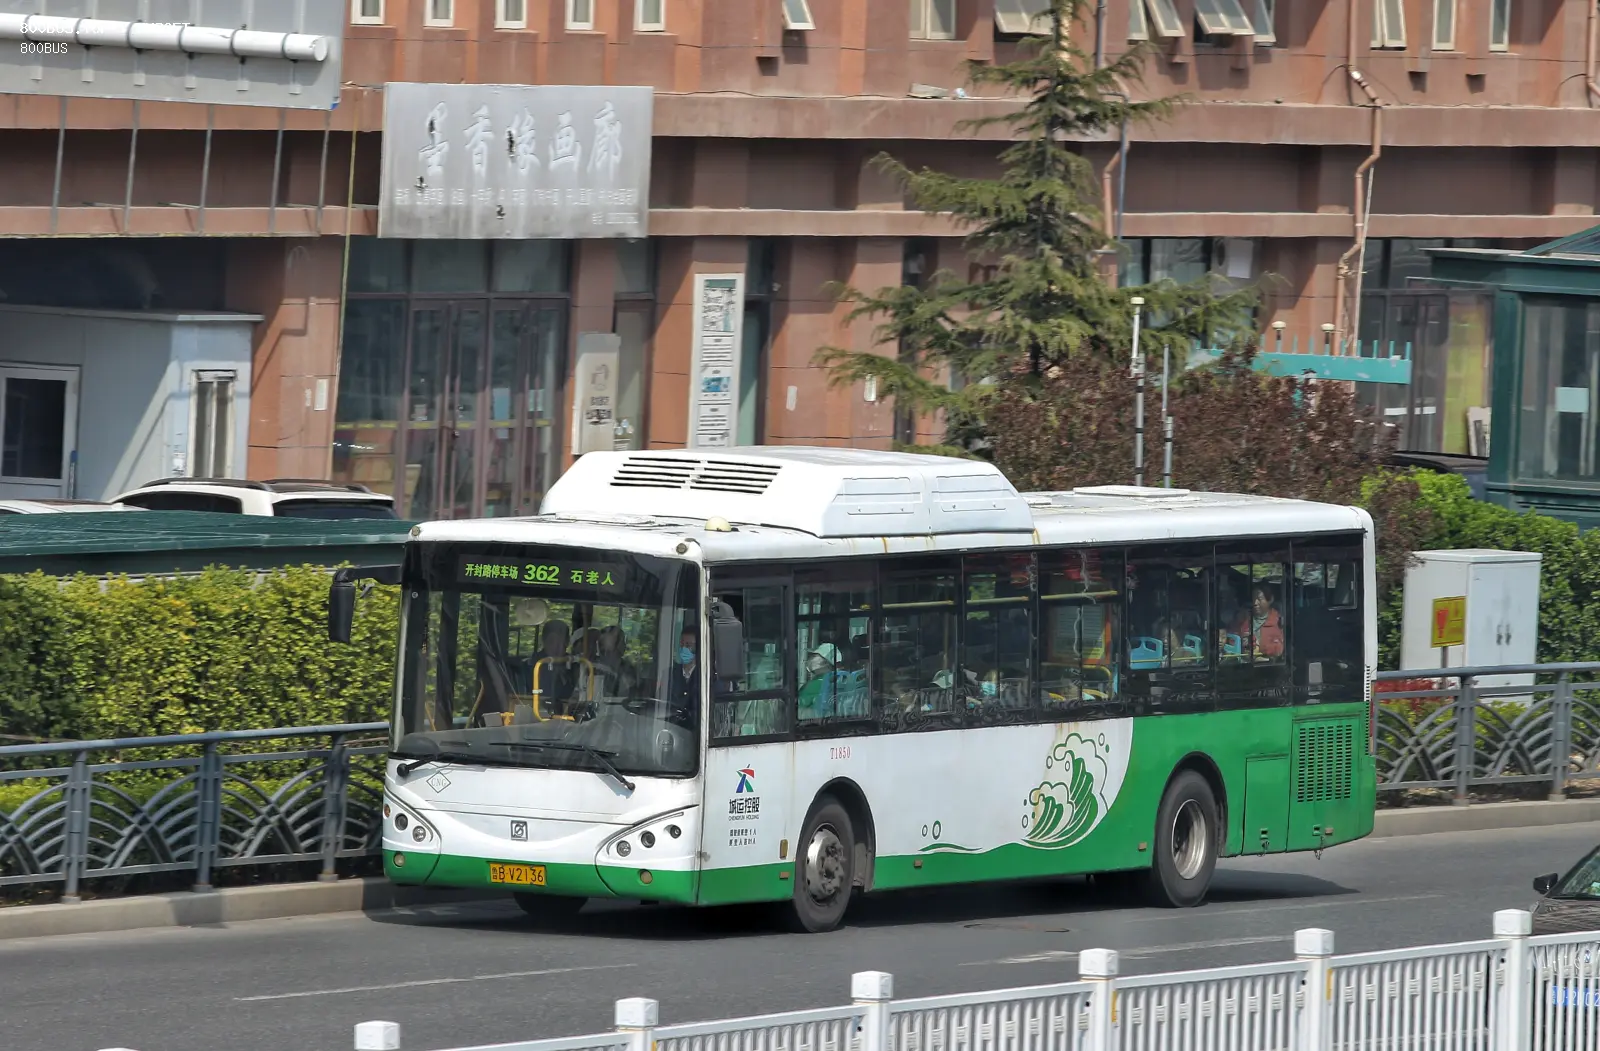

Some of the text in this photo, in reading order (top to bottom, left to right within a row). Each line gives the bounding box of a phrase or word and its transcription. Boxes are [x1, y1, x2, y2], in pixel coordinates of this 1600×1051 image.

[465, 563, 615, 586] 开封路停车场 362 石老人
[431, 777, 447, 787] CNG
[728, 796, 760, 814] 城运控股
